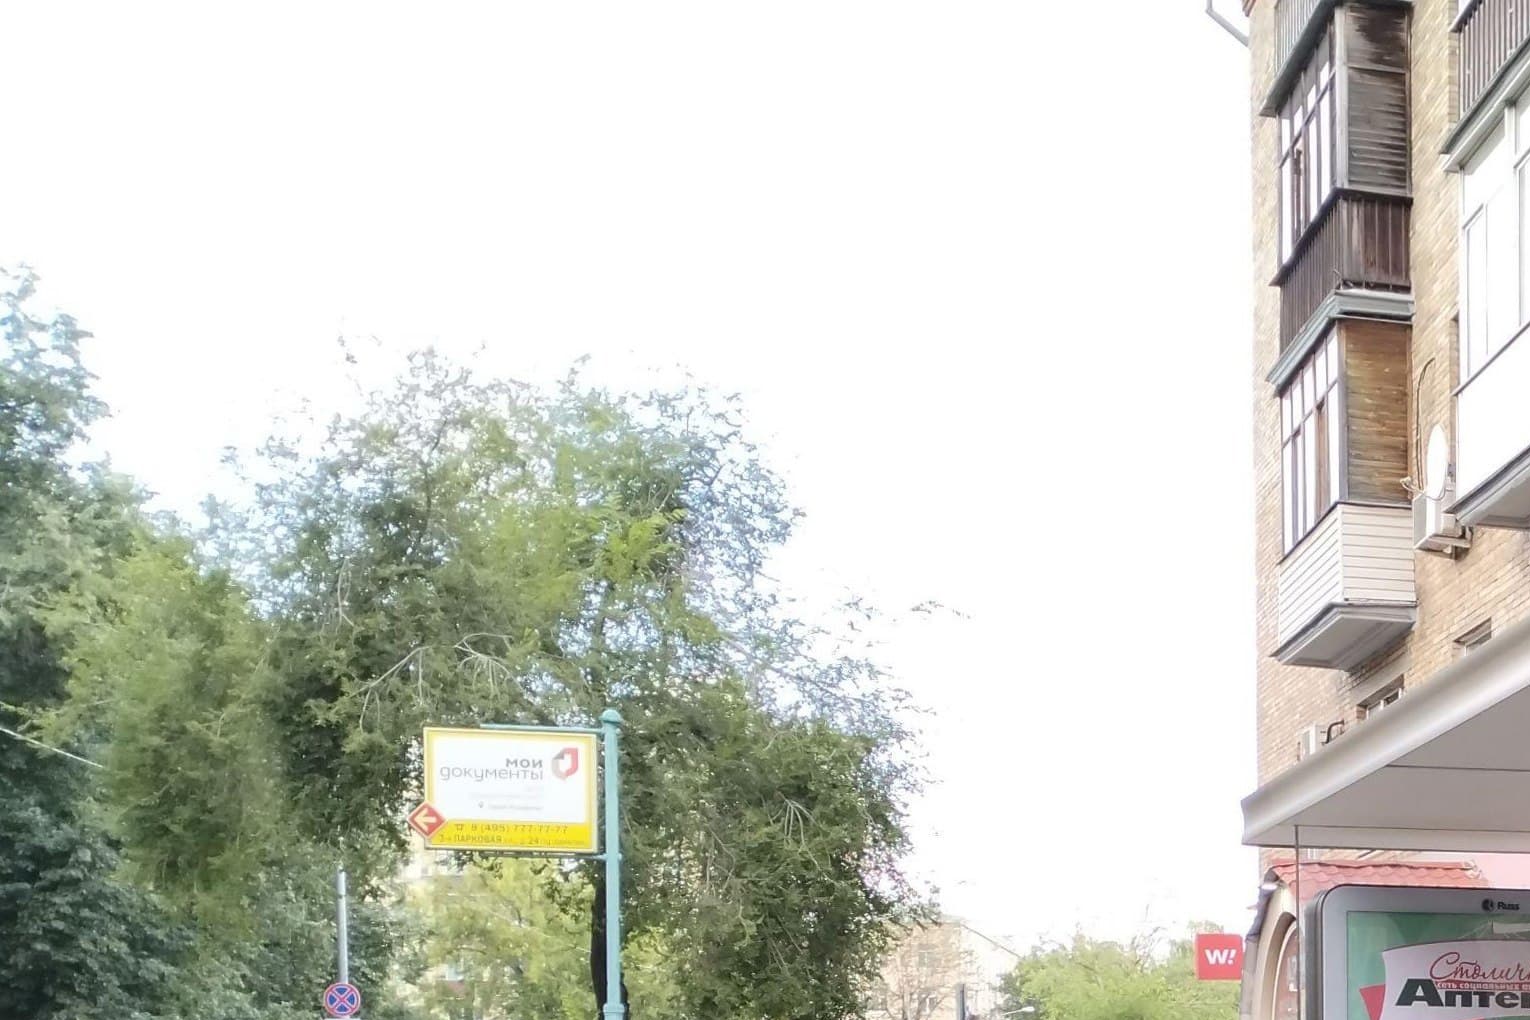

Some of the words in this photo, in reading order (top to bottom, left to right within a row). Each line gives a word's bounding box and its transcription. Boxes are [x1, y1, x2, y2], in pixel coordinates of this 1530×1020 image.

[505, 758, 543, 768] мои
[439, 766, 543, 782] документы
[1497, 901, 1520, 910] Russ
